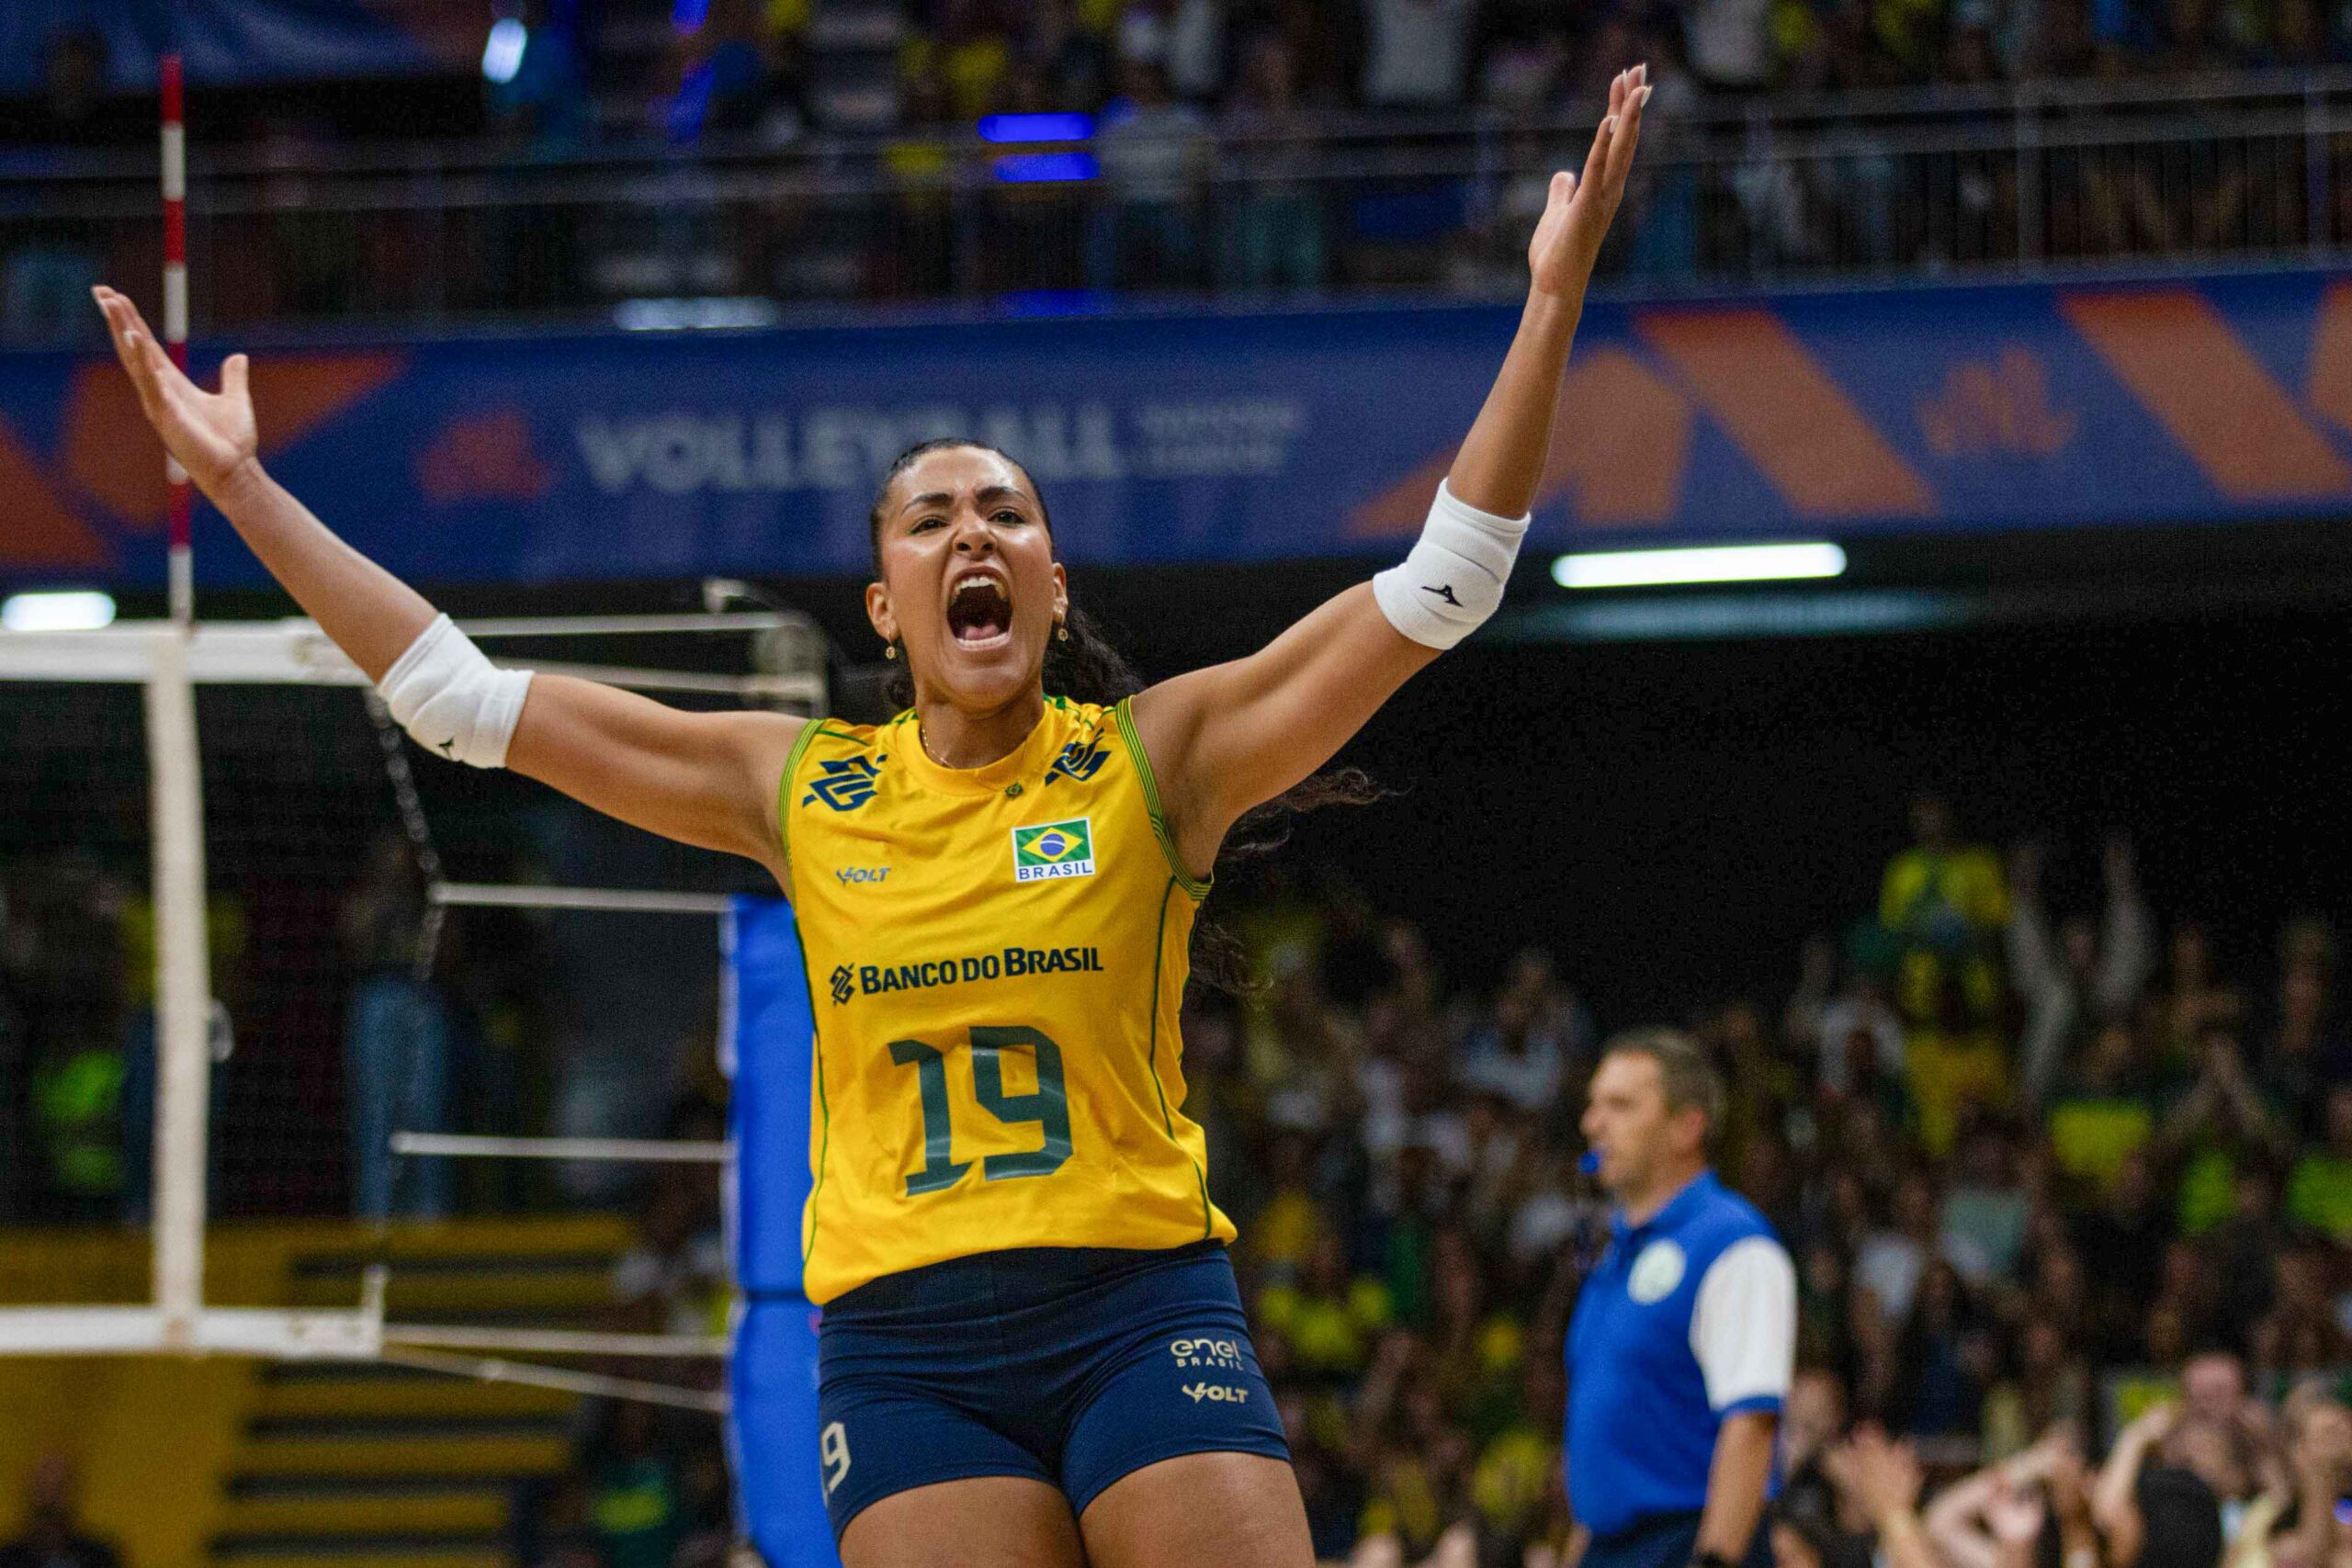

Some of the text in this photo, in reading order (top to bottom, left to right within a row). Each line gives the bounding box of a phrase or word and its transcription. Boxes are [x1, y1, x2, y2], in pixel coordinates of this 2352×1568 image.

[836, 866, 890, 886] VOLT
[1019, 862, 1092, 880] BRASIL
[860, 947, 1104, 995] BANCO DO BRASIL
[888, 1025, 1074, 1196] 19
[1170, 1338, 1241, 1361] enel
[1177, 1357, 1243, 1371] BRASIL
[1182, 1382, 1248, 1404] VOLT
